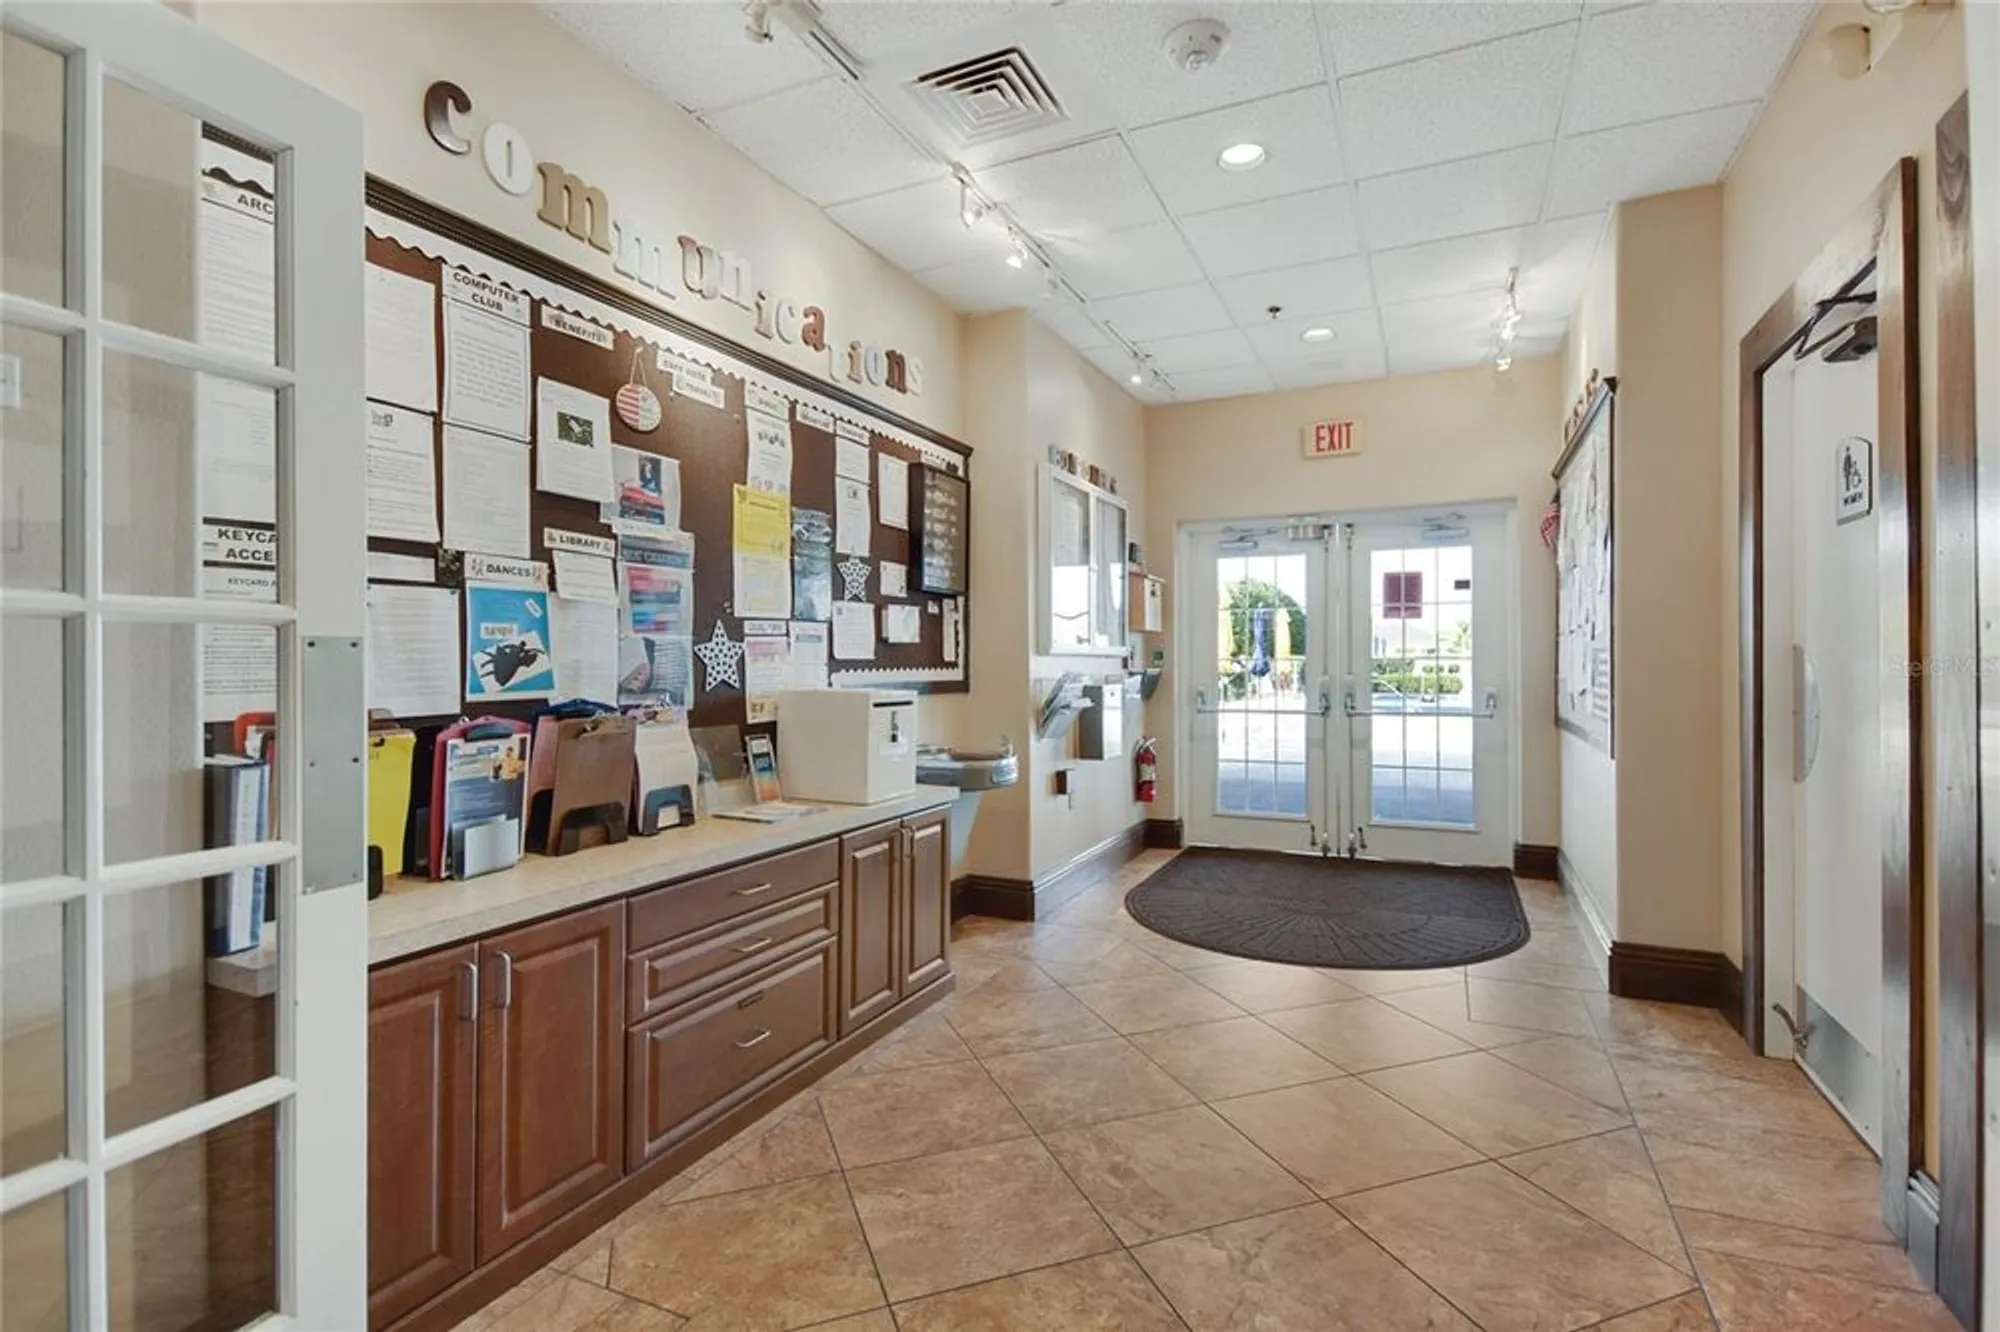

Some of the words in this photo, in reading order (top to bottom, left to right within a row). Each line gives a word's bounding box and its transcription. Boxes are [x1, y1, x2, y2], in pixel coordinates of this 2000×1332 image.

[453, 271, 520, 305] COMPUTER
[471, 292, 504, 313] CLUB
[1315, 422, 1354, 453] EXIT
[559, 534, 602, 550] LIBRARY
[226, 548, 273, 562] ACCE
[485, 562, 531, 577] DANCES
